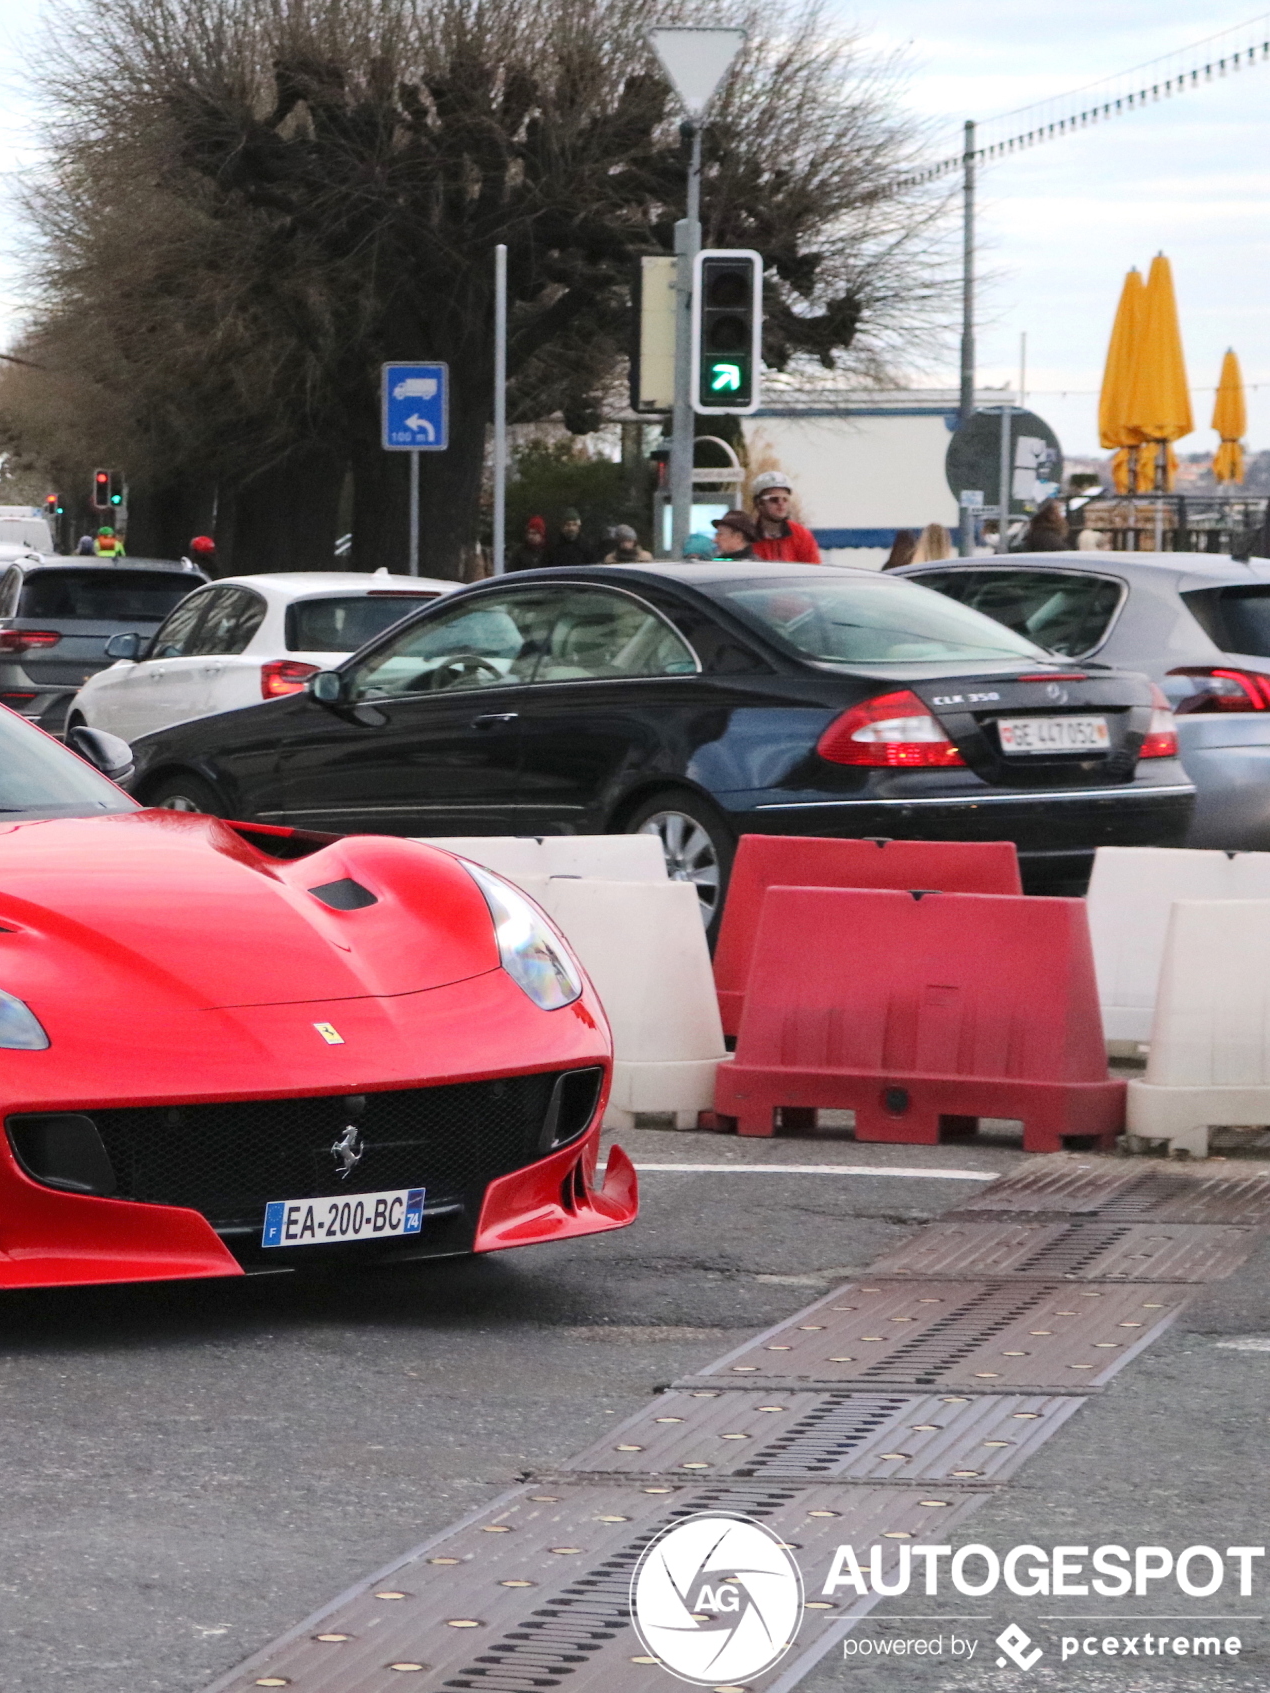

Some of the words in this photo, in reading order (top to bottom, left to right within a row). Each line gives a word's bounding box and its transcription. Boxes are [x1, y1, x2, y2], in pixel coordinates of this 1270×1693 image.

[391, 432, 411, 442] 100
[415, 434, 425, 442] m
[932, 694, 965, 706] CLK
[968, 692, 1000, 702] 350
[1013, 723, 1033, 746] GE
[269, 1227, 277, 1239] F
[284, 1196, 404, 1240] EA-200-BC
[406, 1213, 420, 1229] 74
